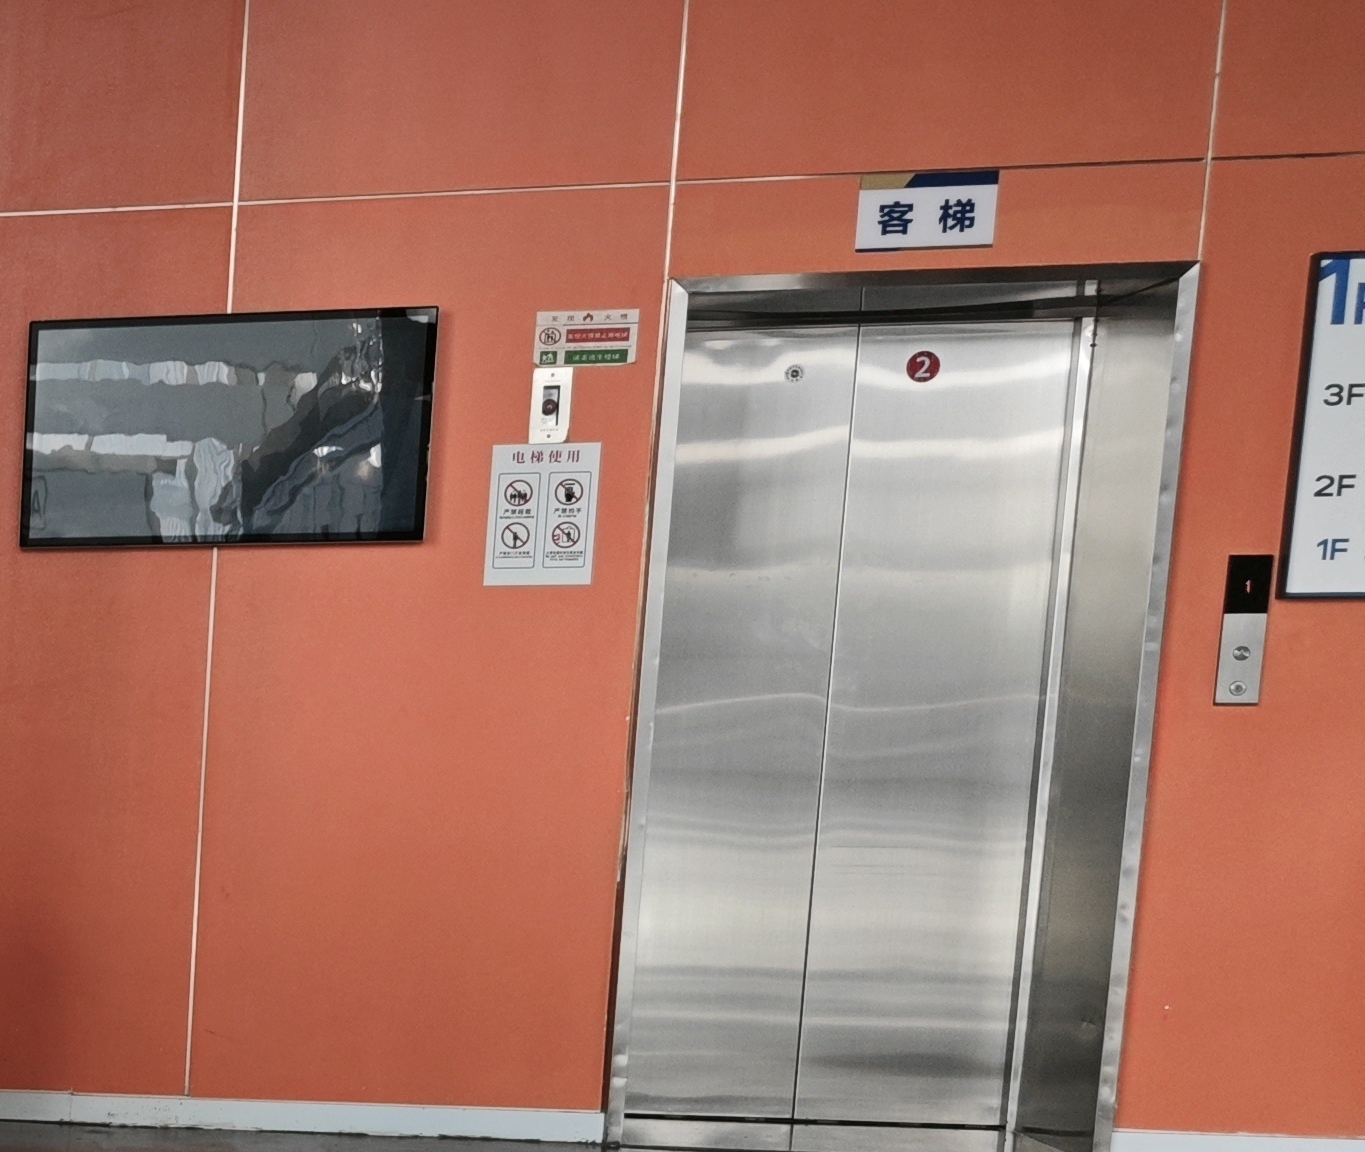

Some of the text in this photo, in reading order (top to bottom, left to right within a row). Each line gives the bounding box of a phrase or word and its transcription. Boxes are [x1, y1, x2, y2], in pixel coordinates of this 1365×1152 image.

[877, 198, 976, 236] 客梯
[1320, 258, 1365, 325] 1
[914, 355, 931, 378] 2
[1323, 382, 1365, 407] 3F
[512, 449, 581, 464] 电梯使用
[1313, 474, 1357, 498] 2F
[1316, 538, 1350, 561] 1F
